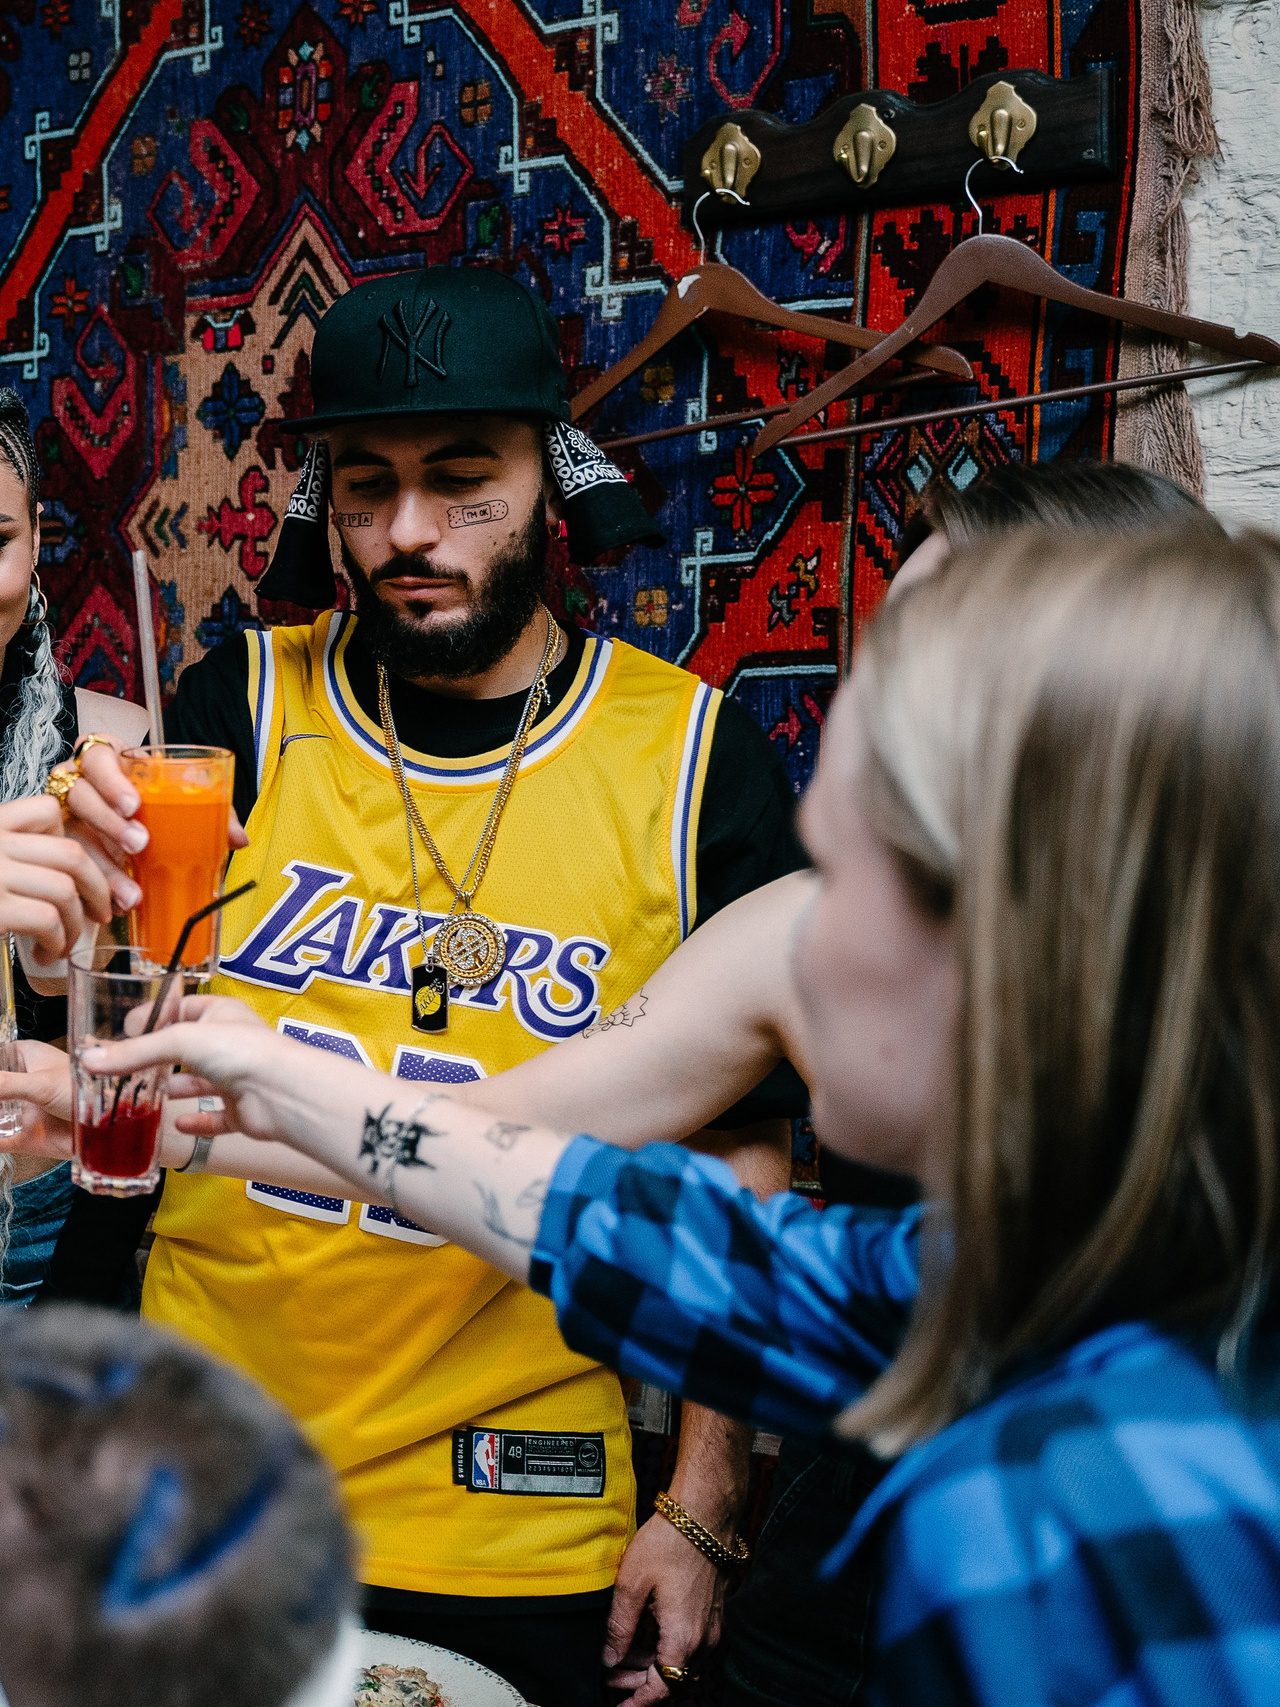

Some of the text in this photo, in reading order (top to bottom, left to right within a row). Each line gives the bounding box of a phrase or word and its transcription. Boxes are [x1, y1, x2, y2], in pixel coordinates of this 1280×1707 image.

[218, 859, 612, 1043] LAKRS
[528, 1438, 575, 1447] ENGINEERED
[508, 1445, 522, 1459] 48
